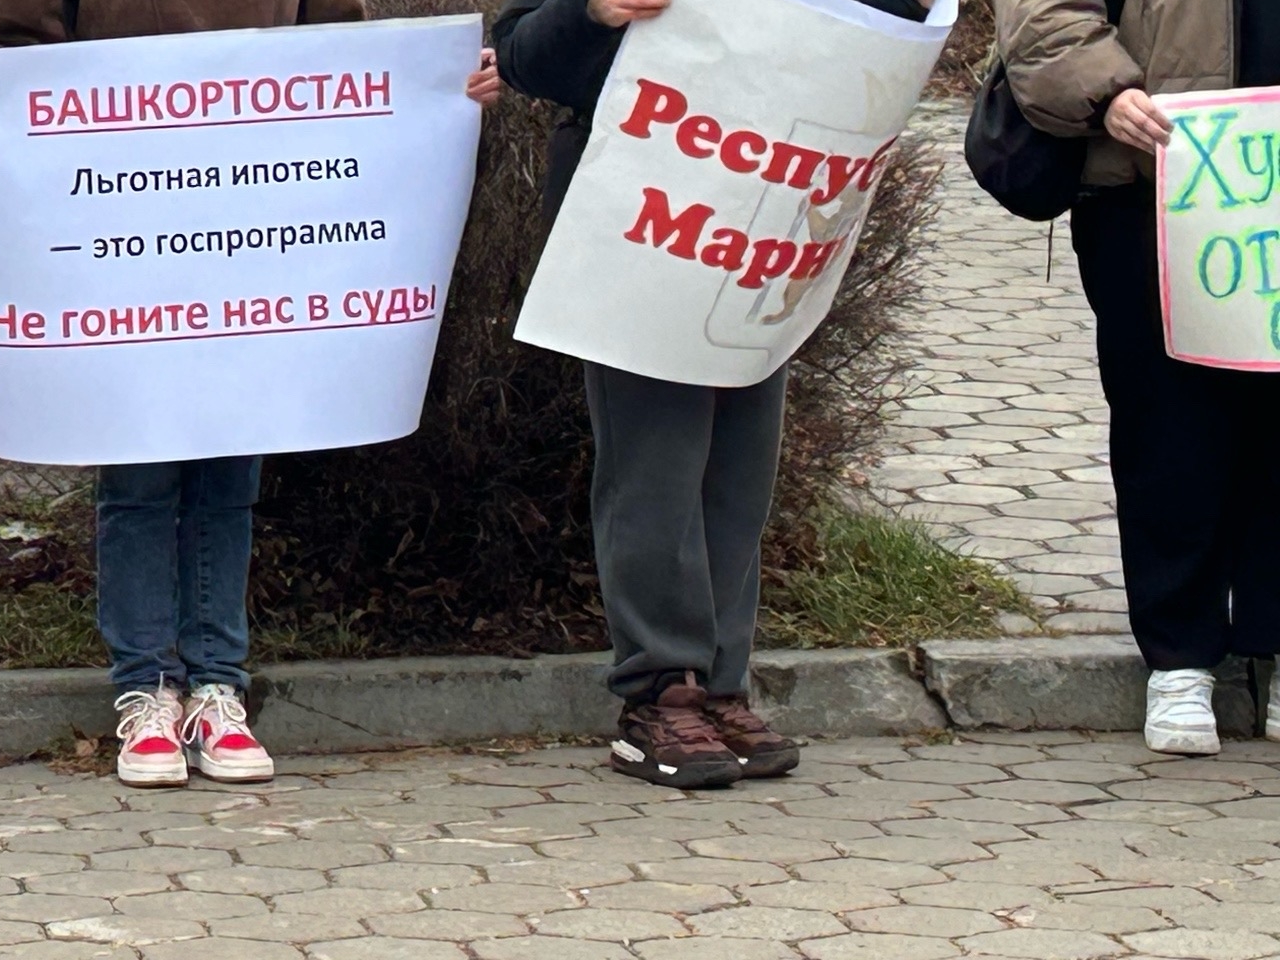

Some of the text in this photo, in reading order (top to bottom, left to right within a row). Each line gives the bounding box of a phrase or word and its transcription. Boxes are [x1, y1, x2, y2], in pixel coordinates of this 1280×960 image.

[27, 70, 392, 128] БАШКОРТОСТАН
[70, 153, 360, 197] Льготная ипотека
[1167, 111, 1280, 212] Ху
[91, 235, 145, 260] это
[156, 218, 387, 257] госпрограмма
[61, 302, 209, 339] гоните
[222, 293, 294, 328] нас
[307, 294, 331, 322] в
[343, 282, 437, 323] суды
